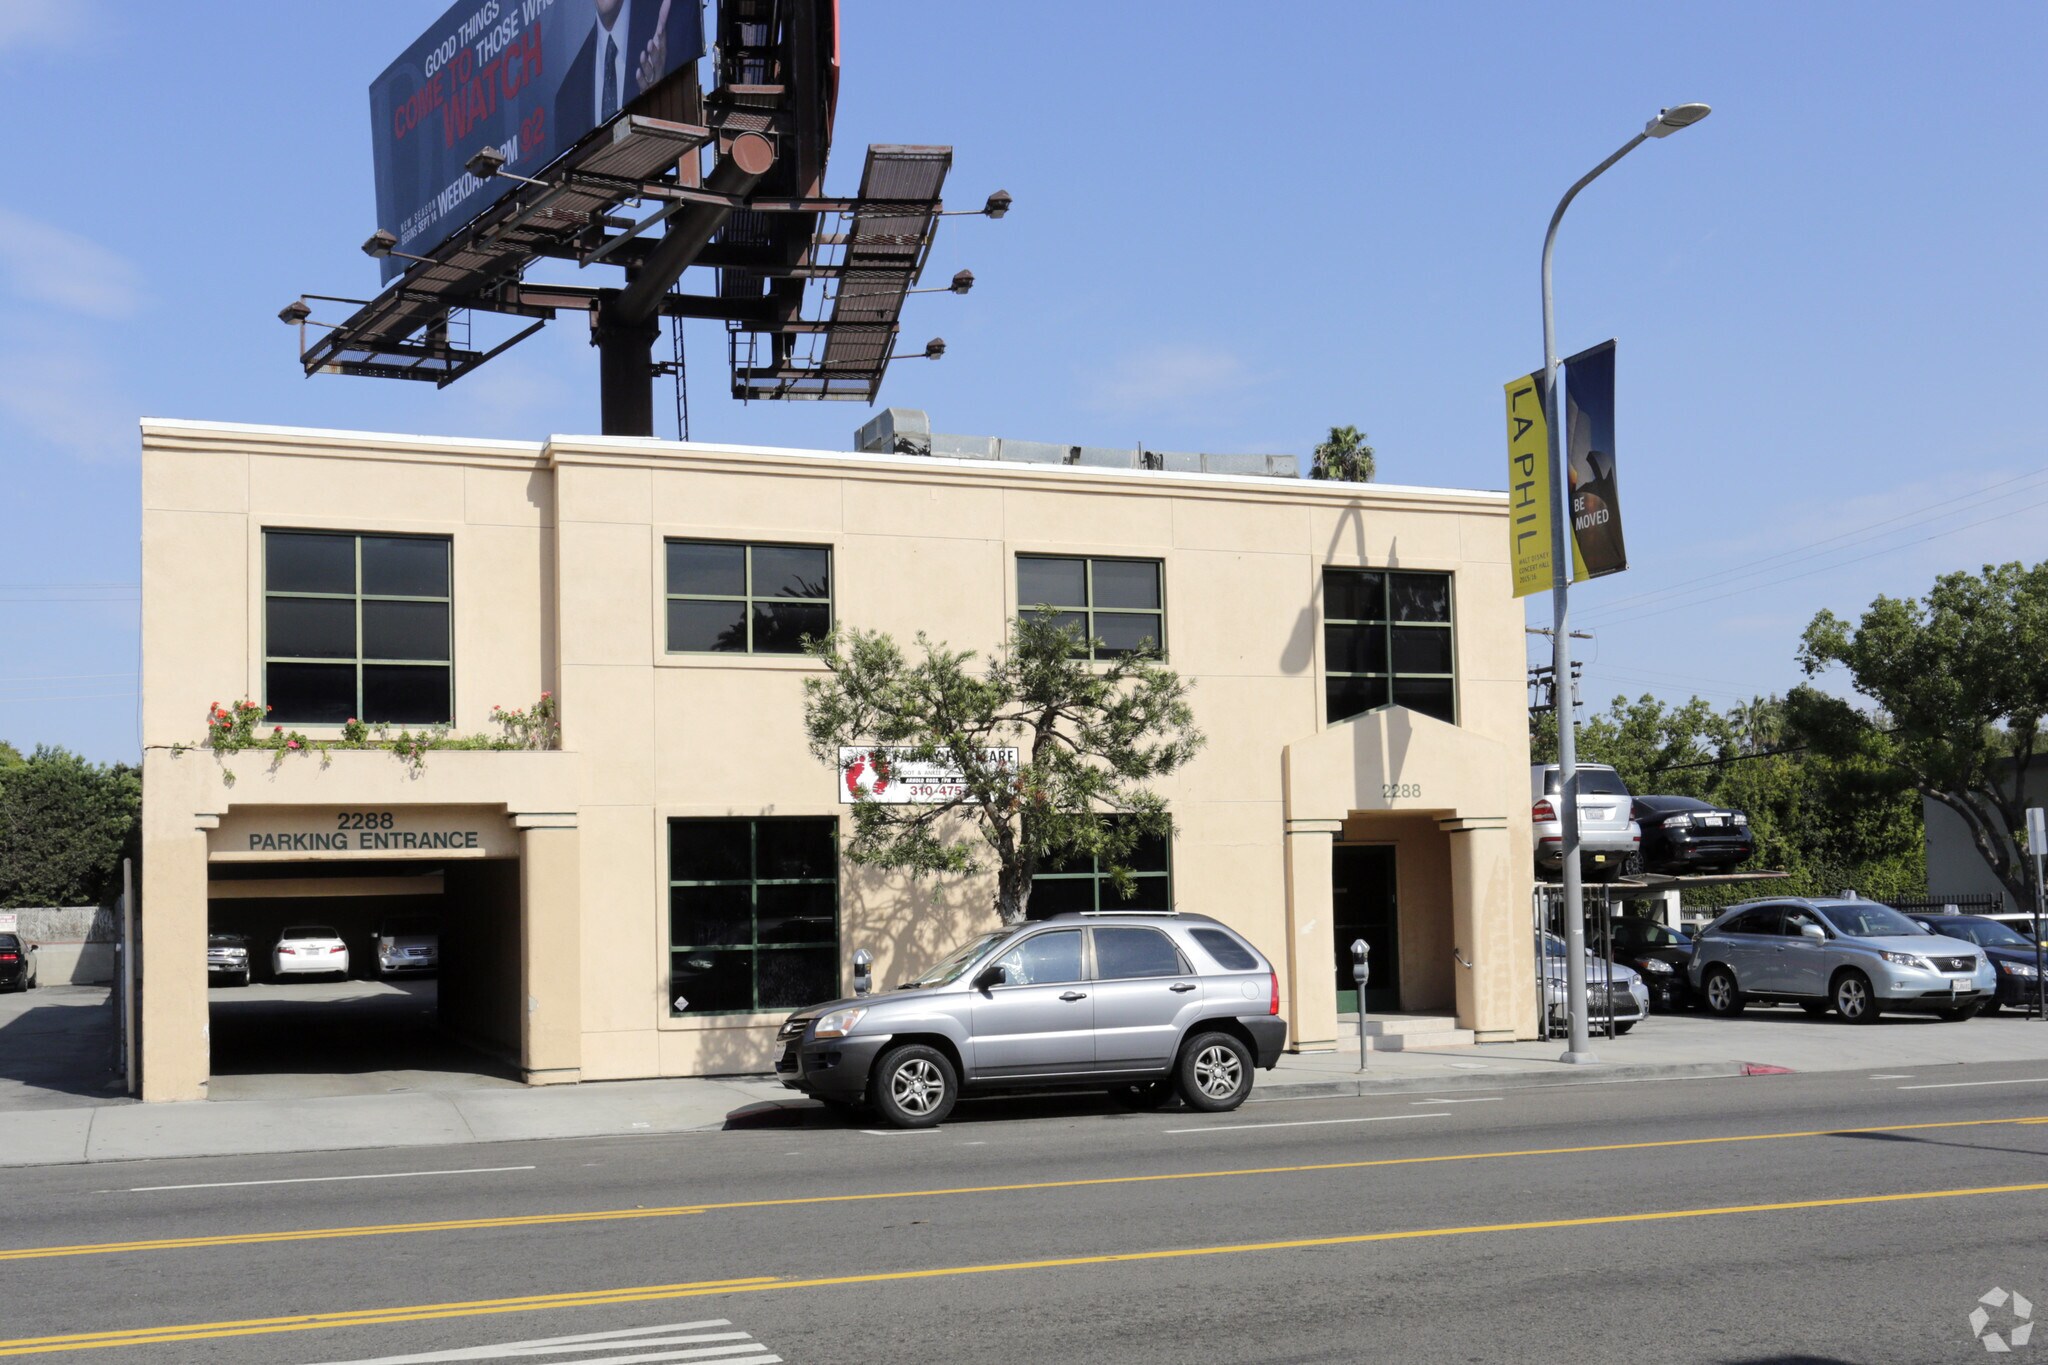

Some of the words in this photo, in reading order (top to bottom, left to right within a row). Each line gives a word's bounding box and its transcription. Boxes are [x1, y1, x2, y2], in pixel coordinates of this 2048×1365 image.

[425, 35, 456, 78] GOOD
[458, 0, 500, 48] THINGS
[394, 71, 444, 140] COME
[448, 47, 472, 93] TO
[476, 9, 519, 67] THOSE
[442, 20, 543, 149] WATCH
[437, 170, 492, 218] WEEKDA
[496, 134, 518, 172] PM
[400, 217, 412, 234] NEW
[414, 198, 436, 223] SEASON
[418, 214, 430, 233] SEPT
[1512, 387, 1533, 442] LA
[1514, 453, 1538, 555] PHIL
[1574, 496, 1585, 512] BE
[1575, 508, 1609, 531] MOVED
[1519, 563, 1538, 575] CONCERT
[894, 750, 940, 762] FAY
[1382, 783, 1422, 799] 2288
[337, 812, 394, 830] 2288
[249, 832, 348, 851] PARKING
[359, 831, 478, 850] ENTRANCE
